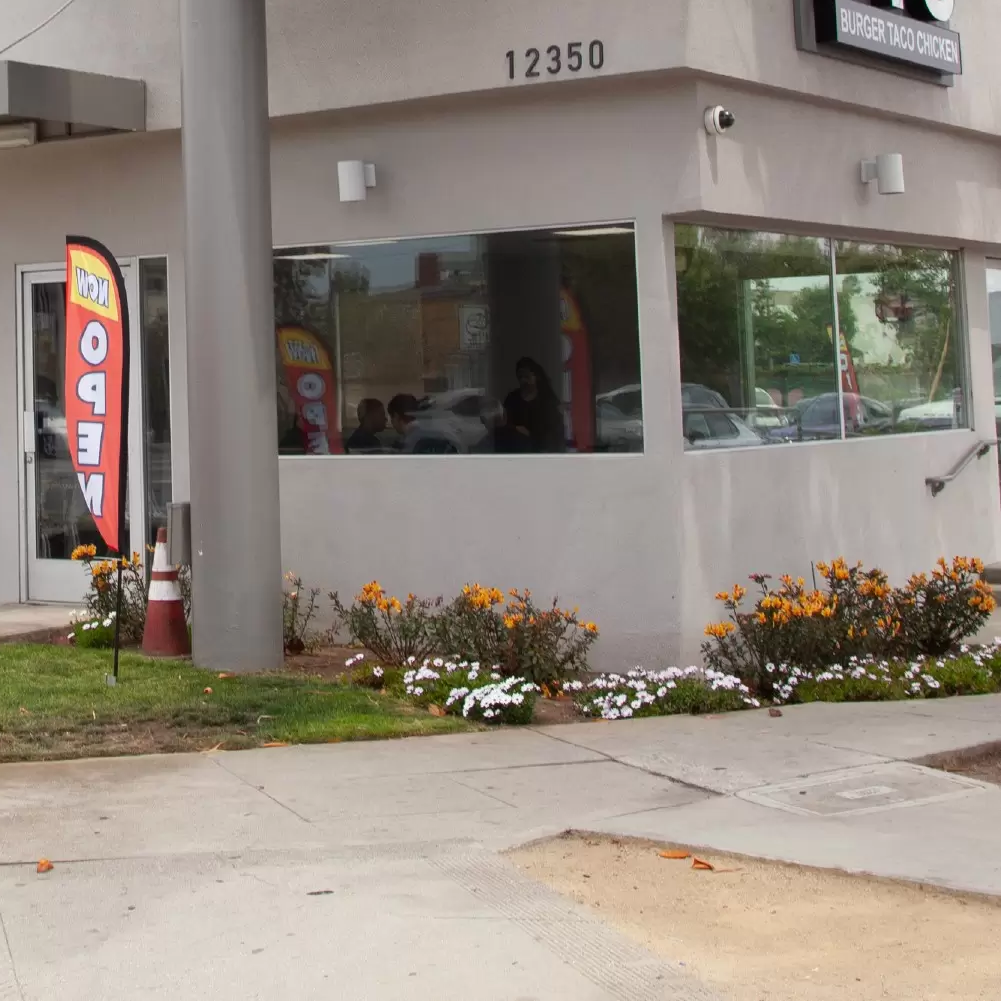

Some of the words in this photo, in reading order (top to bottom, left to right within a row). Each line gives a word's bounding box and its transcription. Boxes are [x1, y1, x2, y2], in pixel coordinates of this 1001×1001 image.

[505, 39, 604, 80] 12350
[840, 7, 886, 44] BURGER
[887, 22, 915, 51] TACO
[916, 31, 958, 64] CHICKEN
